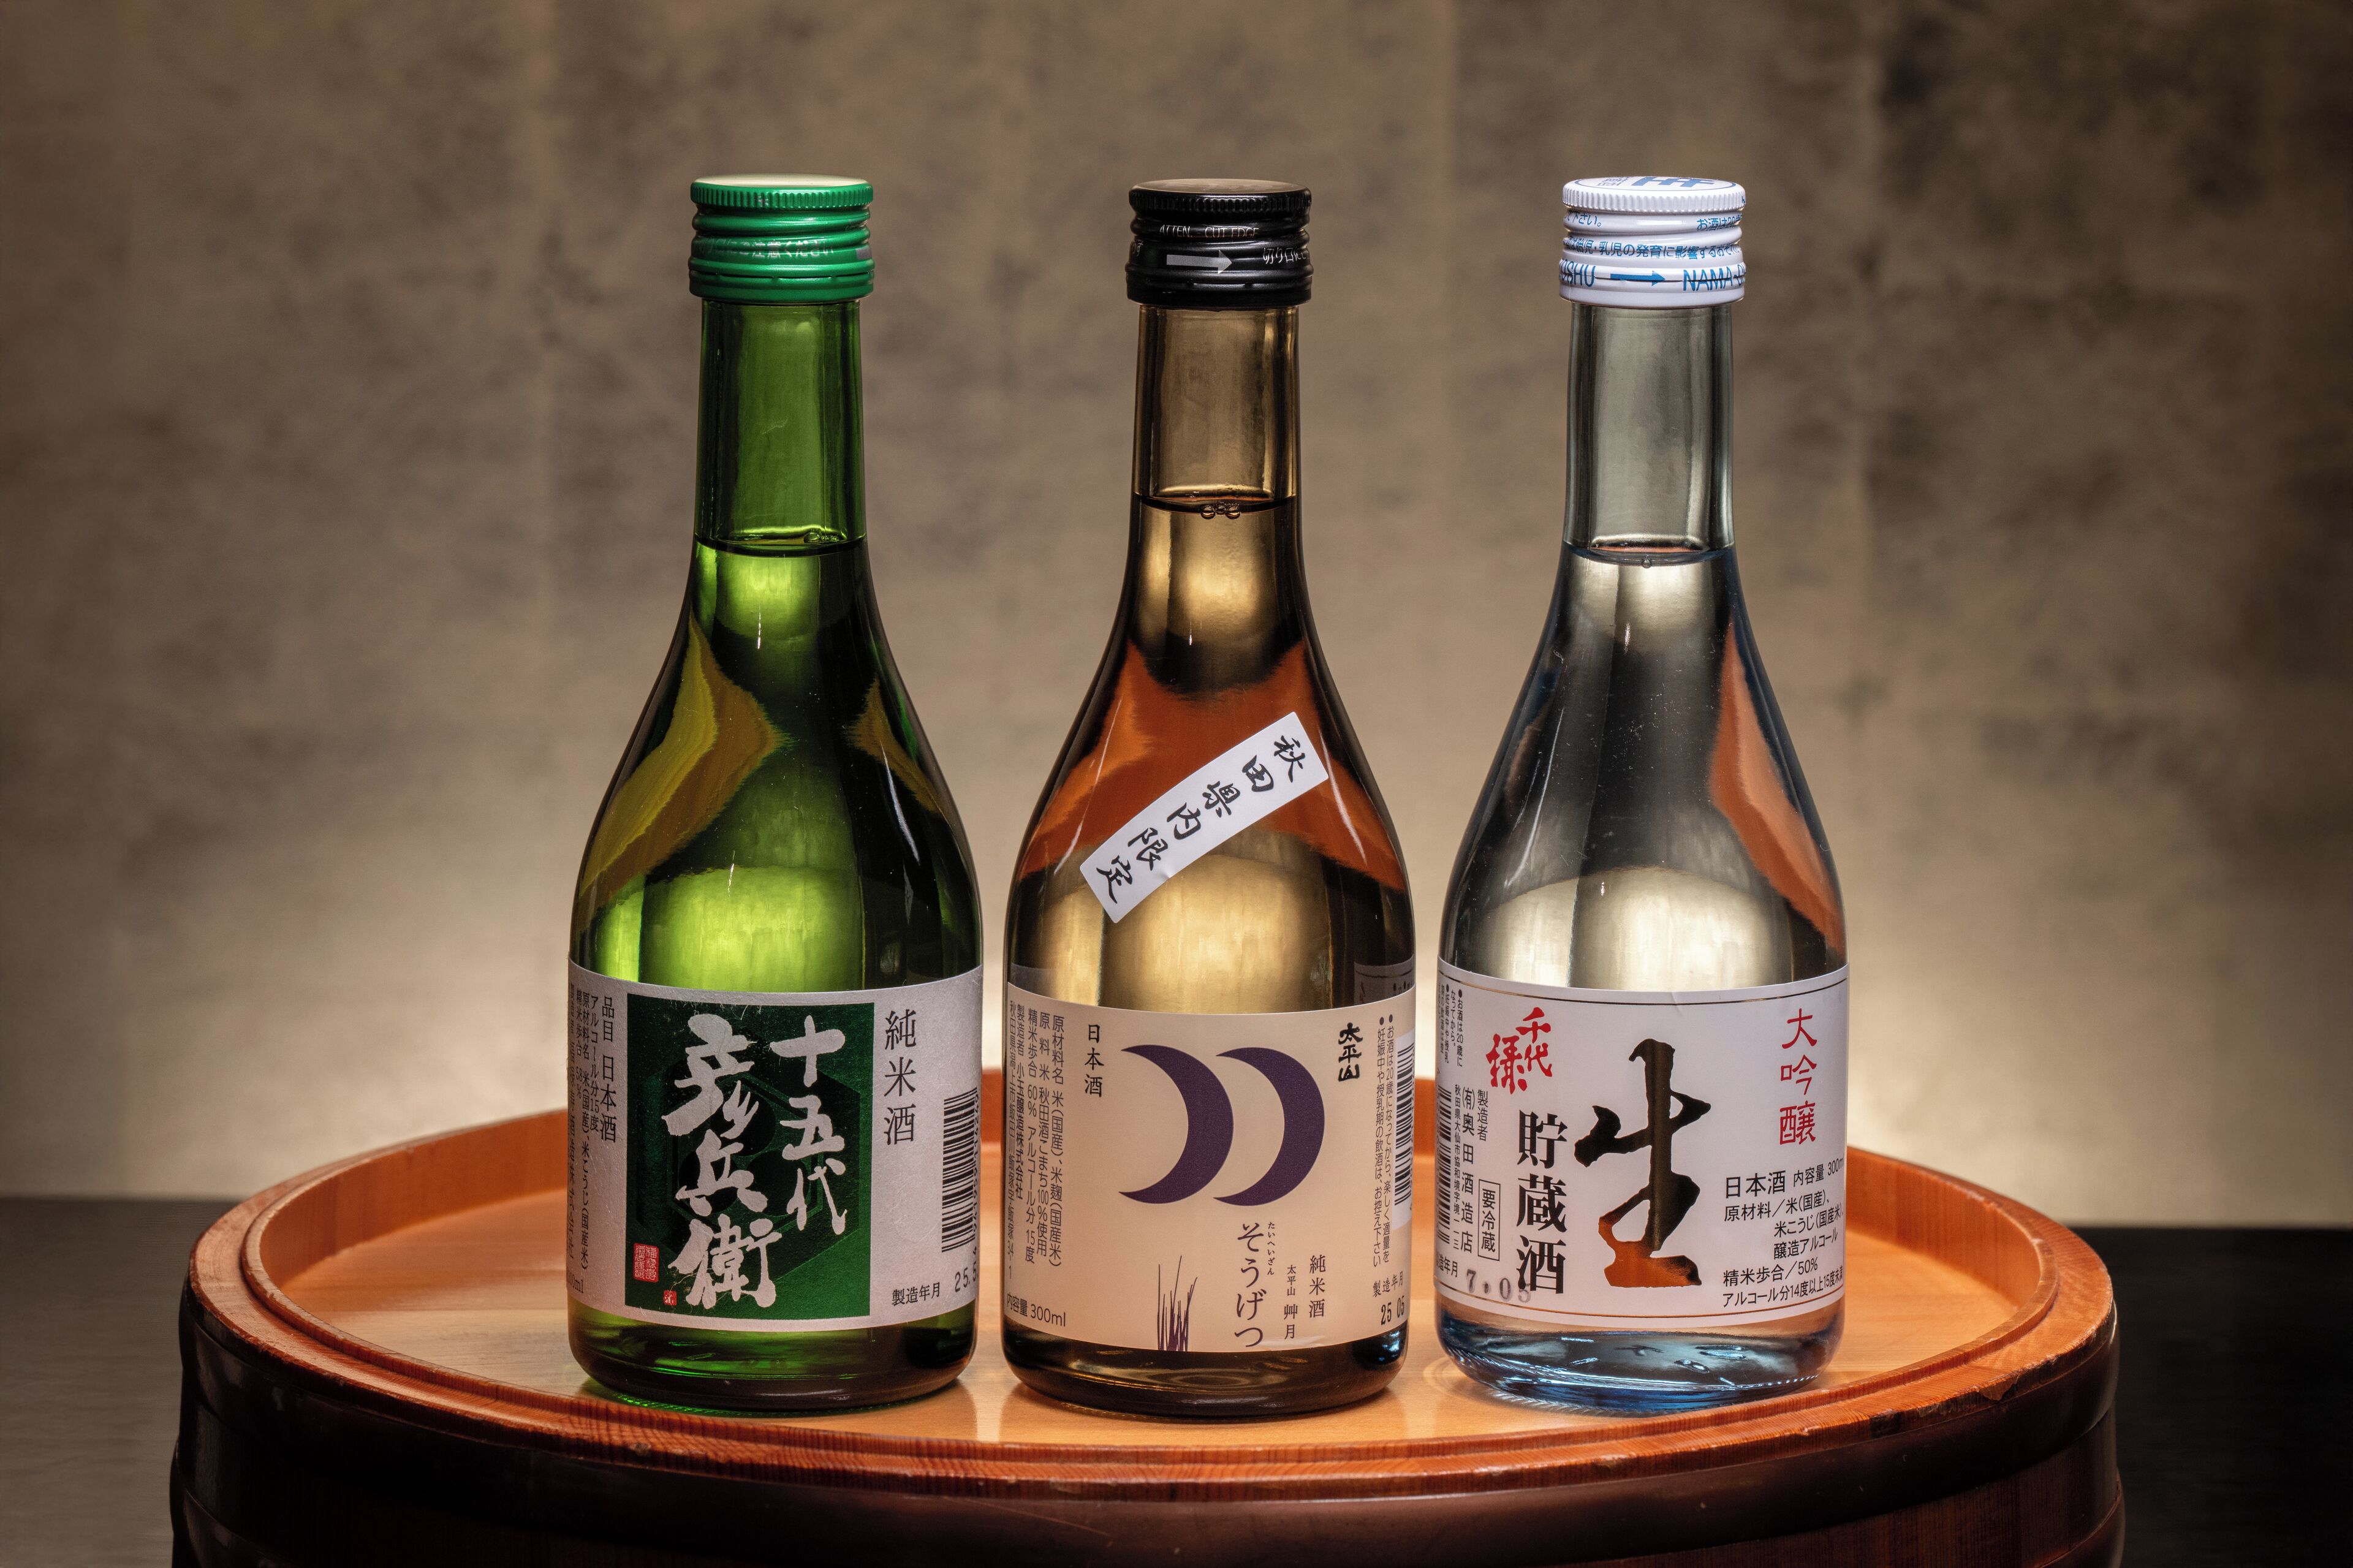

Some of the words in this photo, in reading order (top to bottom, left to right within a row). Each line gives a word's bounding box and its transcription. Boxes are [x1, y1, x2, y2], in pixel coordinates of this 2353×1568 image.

[1159, 225, 1192, 237] ATTEN.
[1205, 227, 1227, 238] CUT
[1231, 227, 1259, 238] EDGE
[1563, 235, 1741, 259] は胎児・乳児の発育に影響するおそ
[1559, 259, 1596, 288] OSHU
[1096, 735, 1305, 903] 秋田県内限定
[602, 995, 615, 1042] 品目
[1028, 1008, 1038, 1078] 精米歩合
[590, 995, 599, 1132] アルコール分15度
[884, 1009, 917, 1146] 純米酒
[1052, 1015, 1064, 1085] 原材料名
[1083, 1024, 1104, 1097] 日本酒
[1338, 1022, 1363, 1082] 太平山
[1779, 1008, 1818, 1146] 大吟醸
[600, 1054, 617, 1143] 日本酒
[770, 1015, 847, 1235] 十五代
[1028, 1085, 1037, 1118] 60%
[1477, 1089, 1488, 1142] 製造者
[1026, 1126, 1037, 1224] アルコール分
[1574, 1039, 1711, 1287] 生
[1726, 1170, 1786, 1199] 日本酒
[1793, 1164, 1824, 1187] 内容量
[1481, 1187, 1496, 1252] 要冷蔵
[1516, 1109, 1568, 1295] 貯蔵酒
[1025, 1230, 1036, 1264] 15度
[1436, 1254, 1458, 1278] 造年月
[1773, 1227, 1838, 1260] 醸造アルコール
[892, 1282, 941, 1306] 製造年月
[1007, 1293, 1028, 1317] 内容量
[1030, 1304, 1066, 1327] 300ml
[1235, 1222, 1267, 1347] そうげつ
[1287, 1265, 1296, 1296] 太平山
[1309, 1254, 1326, 1317] 純米酒
[1373, 1271, 1404, 1298] 製造年月
[1381, 1301, 1392, 1325] 25
[1396, 1295, 1405, 1318] 05
